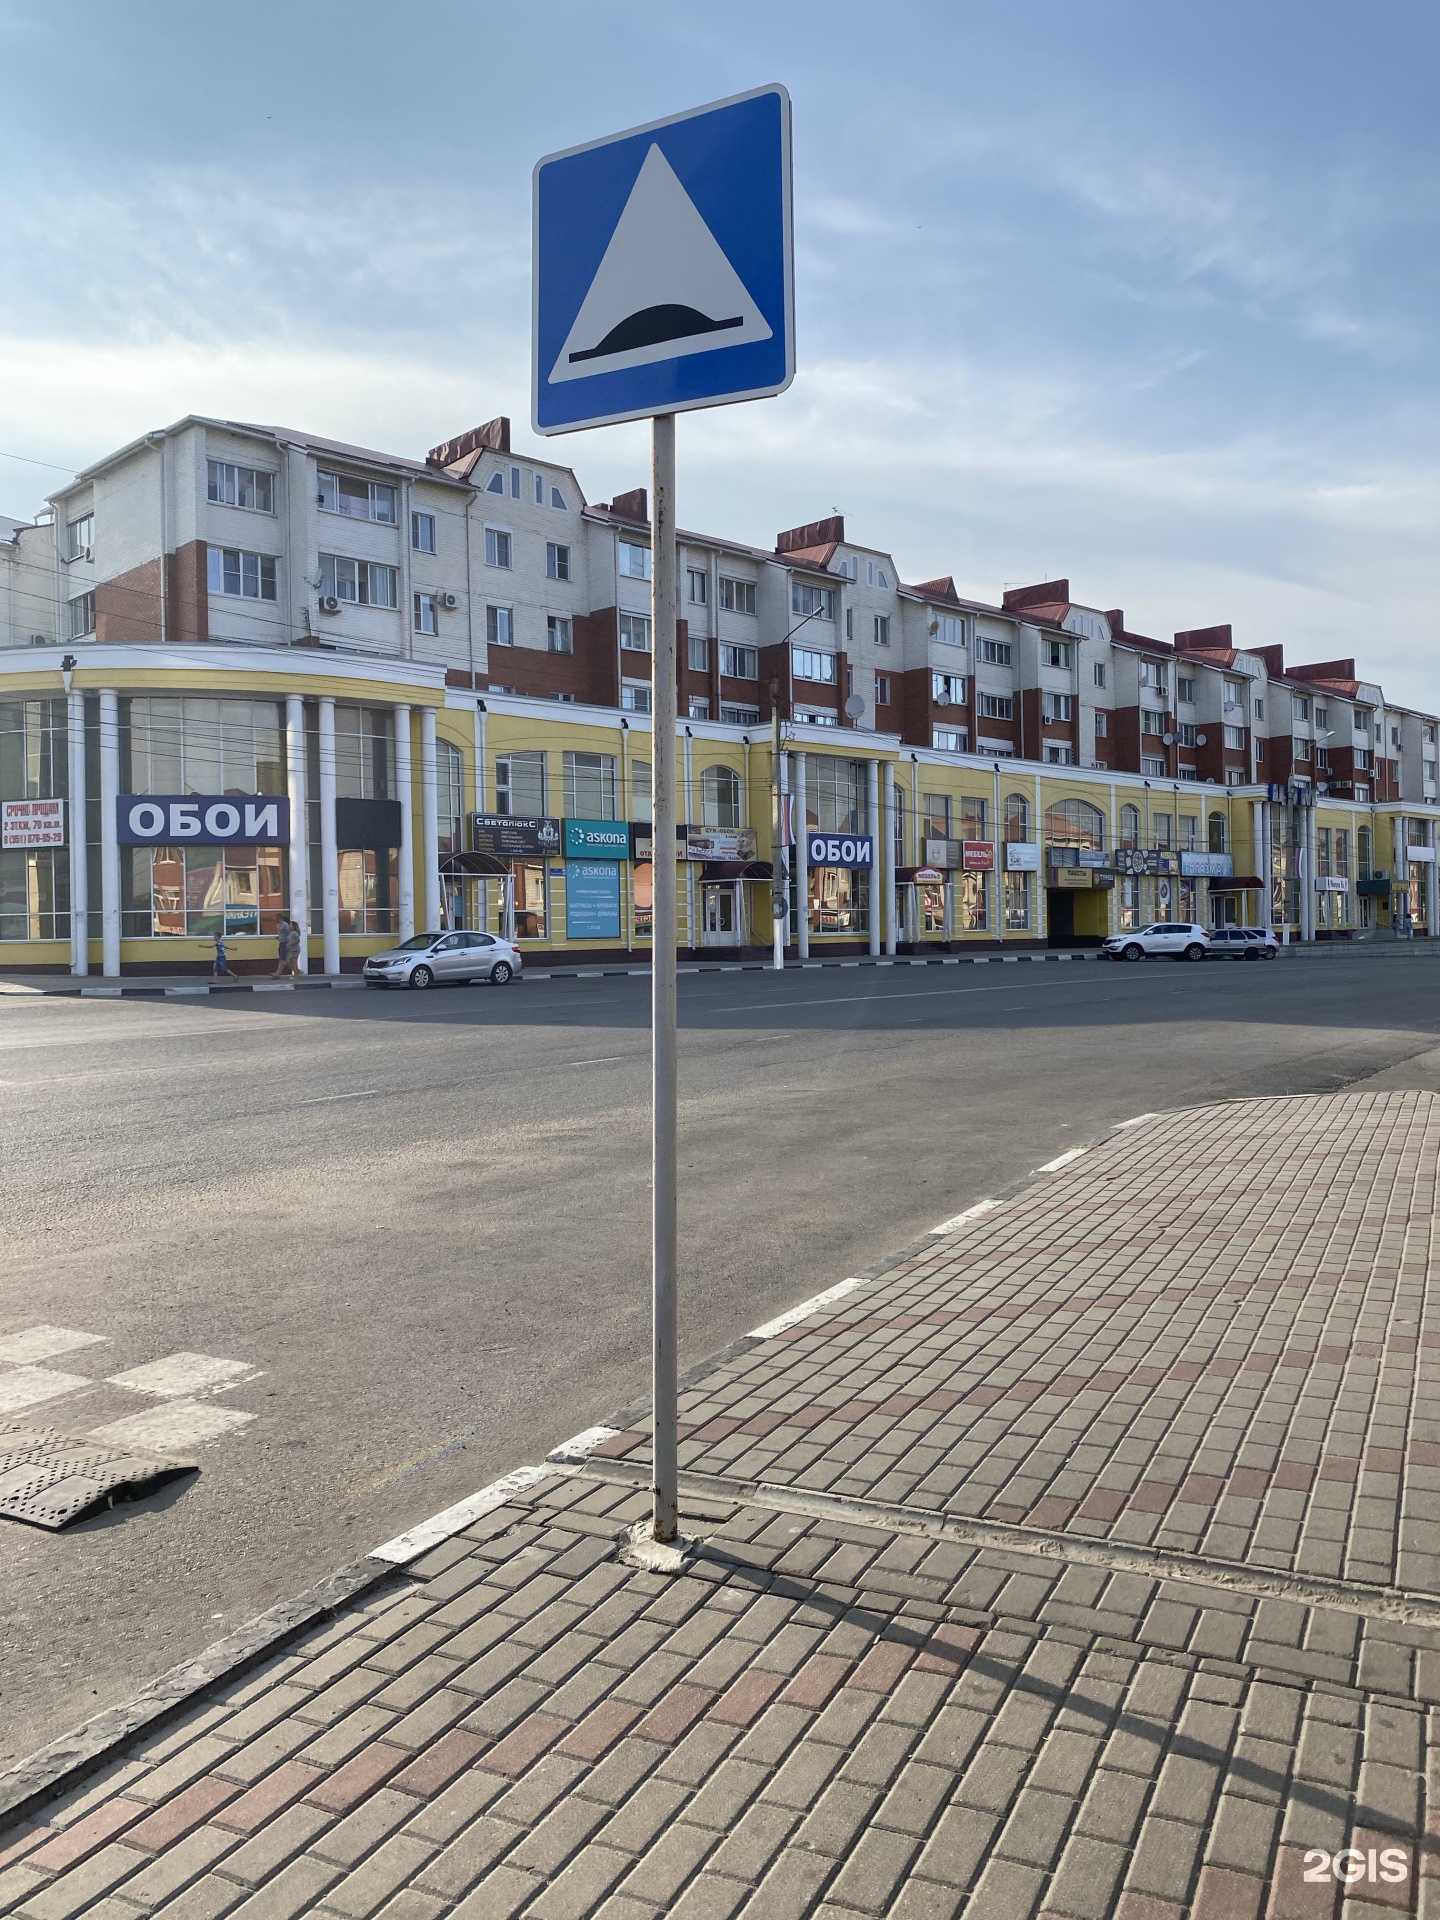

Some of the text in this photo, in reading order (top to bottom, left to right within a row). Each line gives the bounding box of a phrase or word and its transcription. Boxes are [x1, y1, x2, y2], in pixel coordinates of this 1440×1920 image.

[128, 802, 278, 837] ОБОИ
[586, 832, 627, 844] askona
[811, 839, 870, 863] ОБОИ
[582, 866, 617, 876] askona
